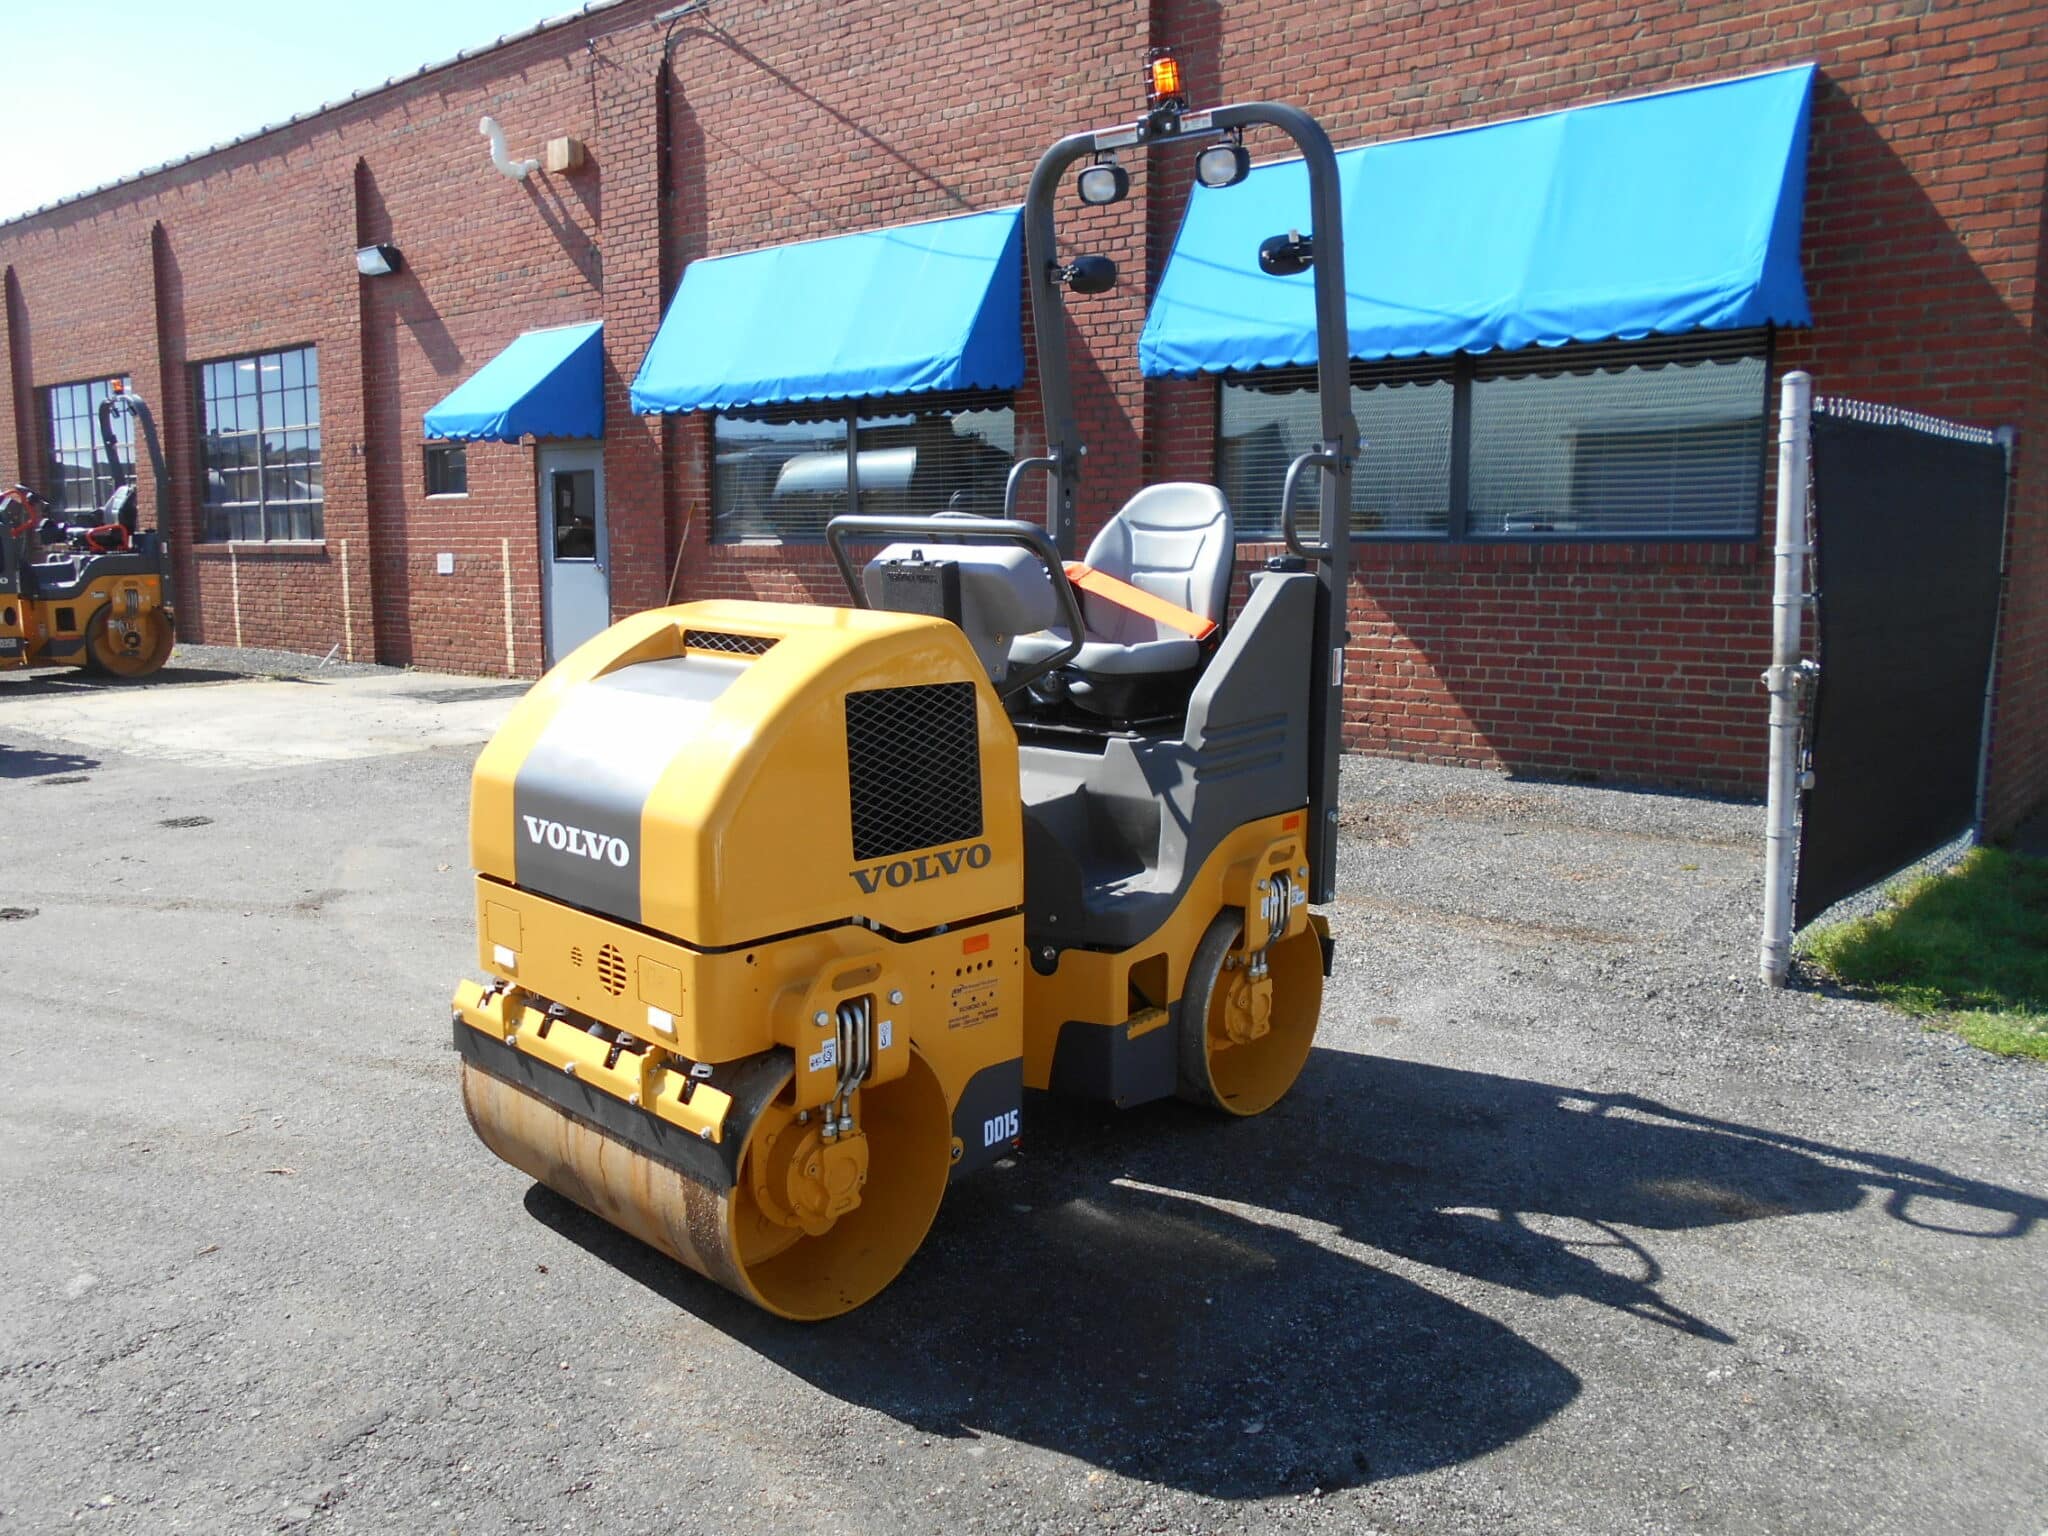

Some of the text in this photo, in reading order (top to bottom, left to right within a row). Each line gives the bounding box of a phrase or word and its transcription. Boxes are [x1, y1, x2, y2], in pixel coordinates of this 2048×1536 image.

[523, 815, 630, 867] VOLVO
[849, 844, 991, 894] VOLVO
[984, 1109, 1018, 1147] DD15
